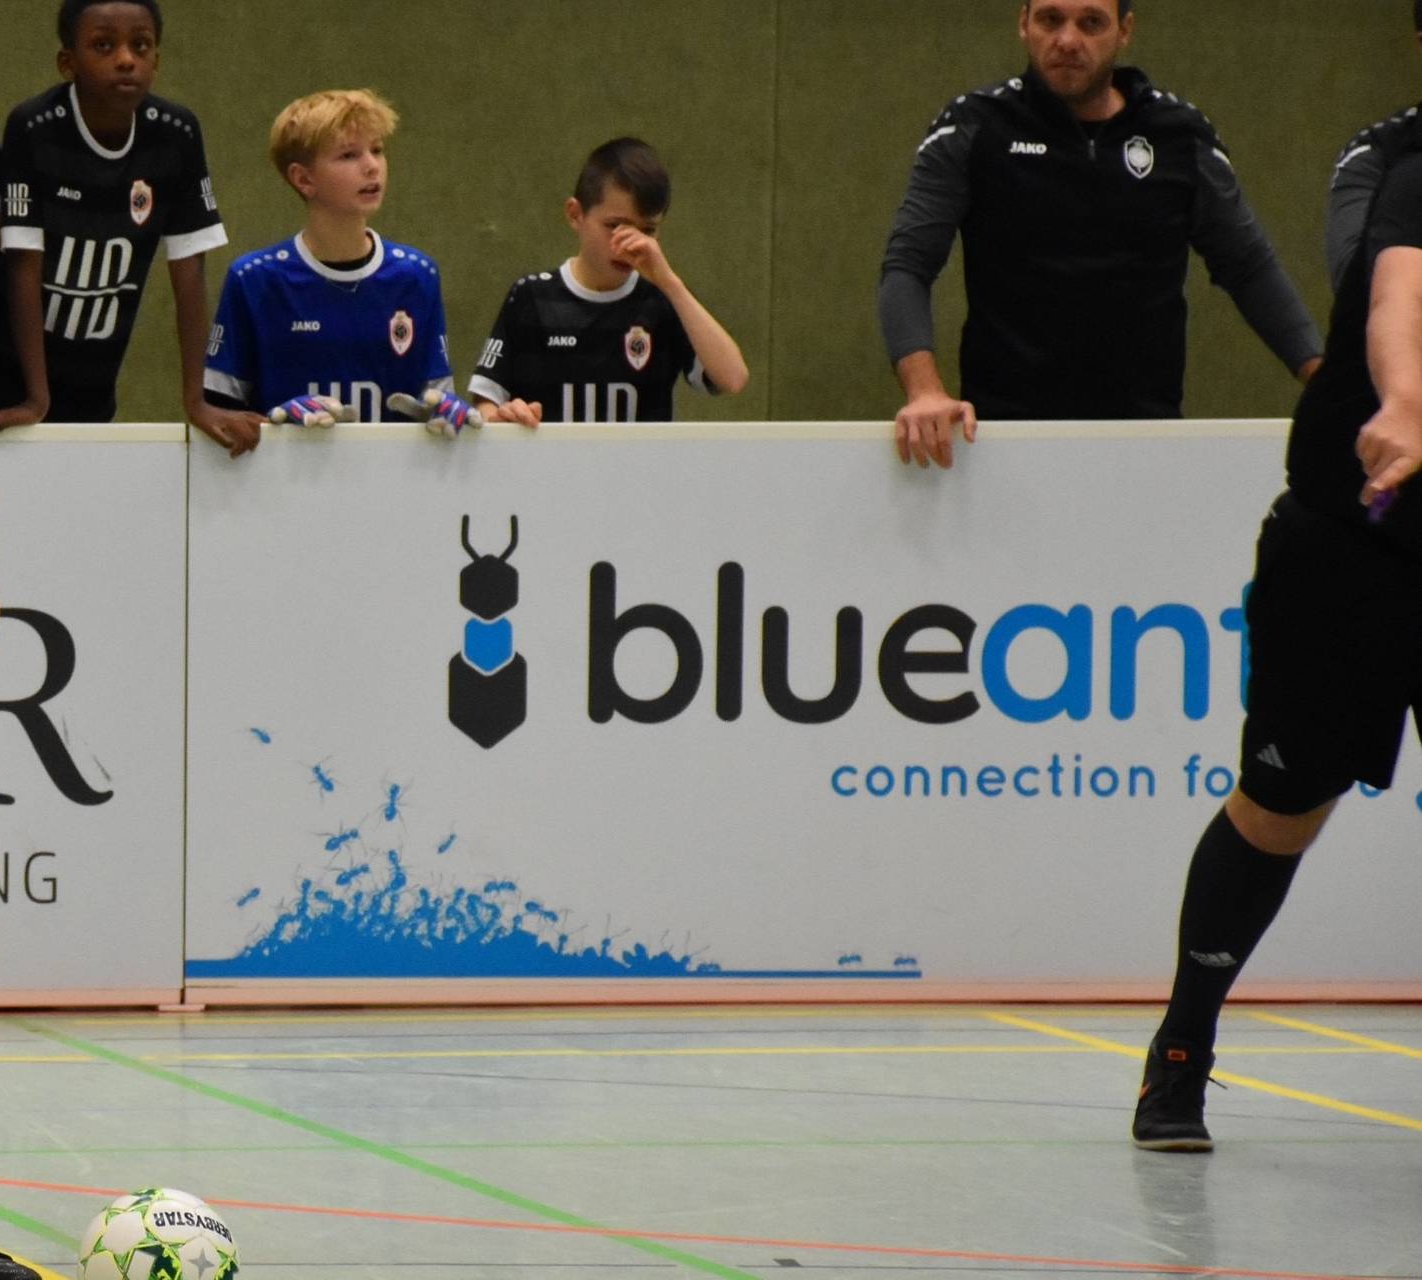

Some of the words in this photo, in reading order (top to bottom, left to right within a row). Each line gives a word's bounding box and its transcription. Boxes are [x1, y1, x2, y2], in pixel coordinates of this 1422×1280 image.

[1010, 141, 1047, 154] JAKO
[291, 321, 320, 331] JAKO
[548, 336, 577, 346] JAKO
[831, 753, 1156, 798] connection
[1184, 753, 1235, 798] fo
[153, 1211, 233, 1243] DERBYSTAR
